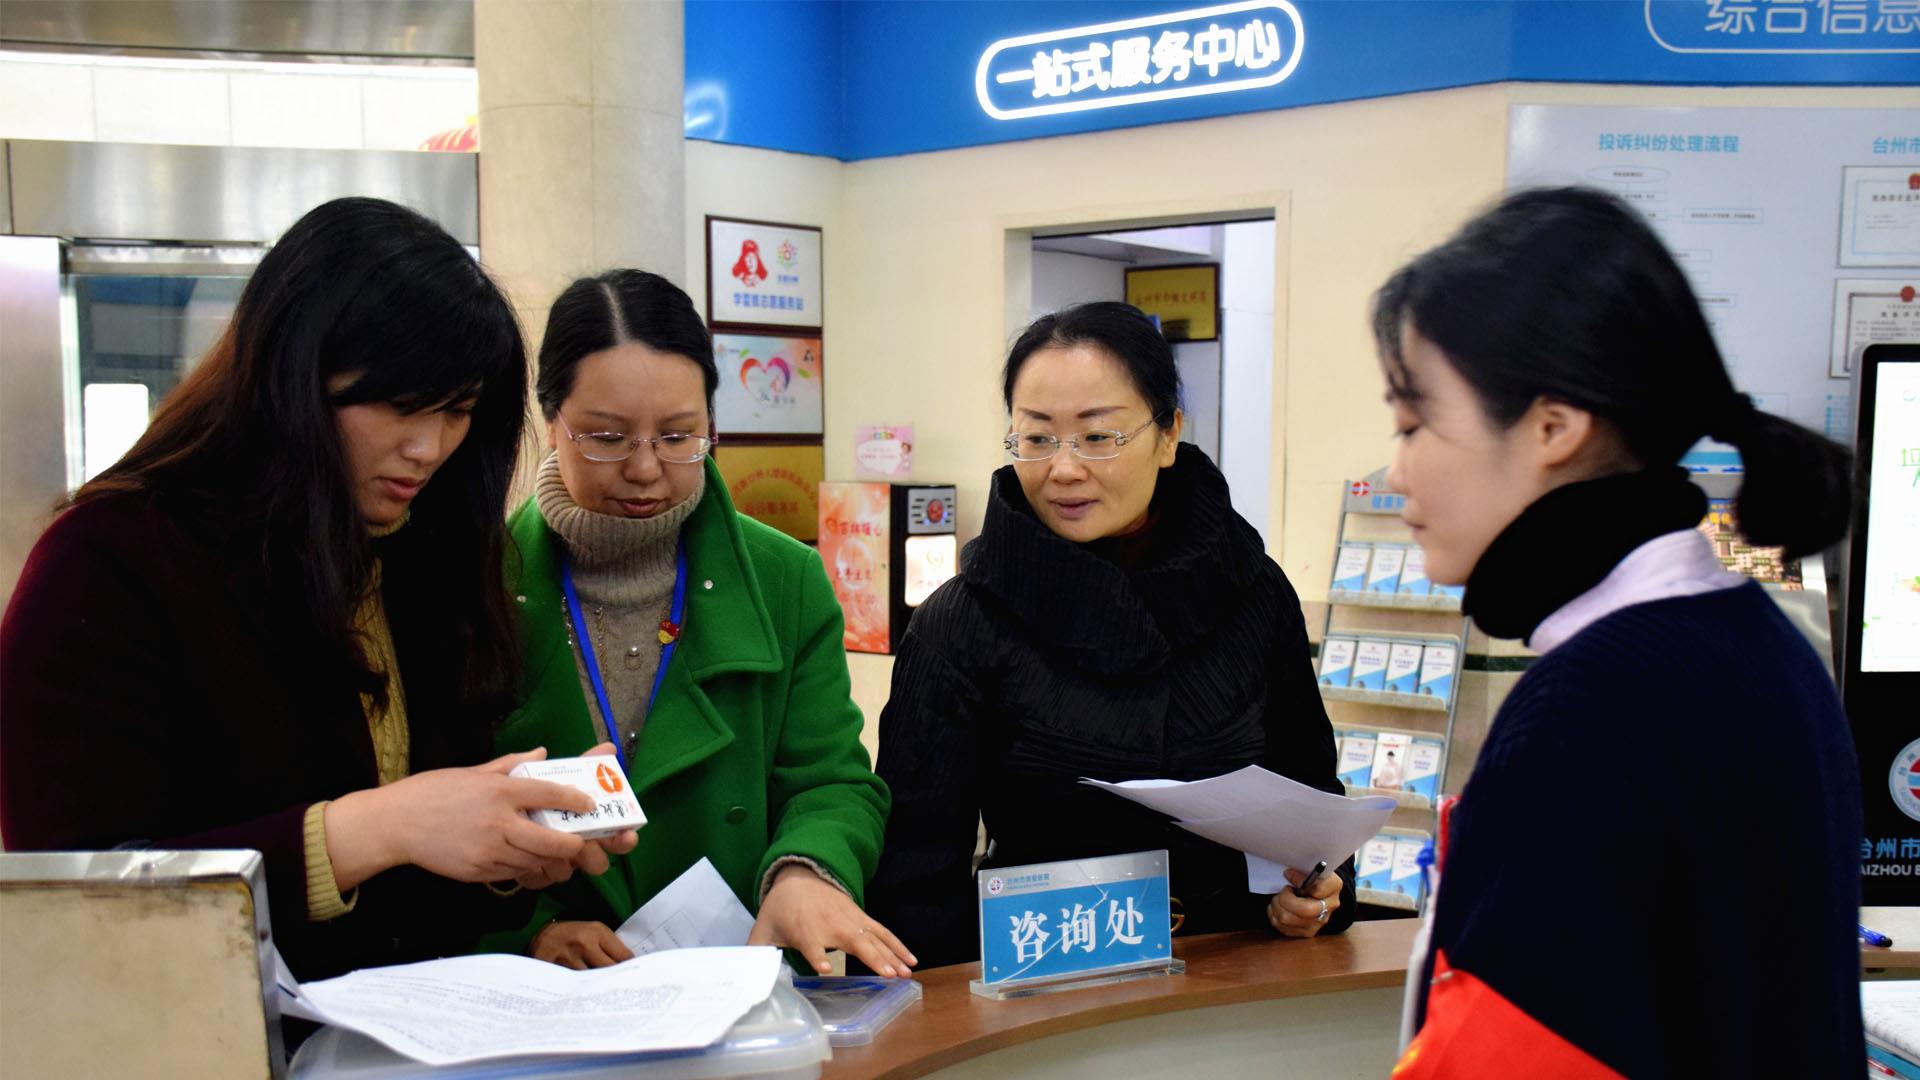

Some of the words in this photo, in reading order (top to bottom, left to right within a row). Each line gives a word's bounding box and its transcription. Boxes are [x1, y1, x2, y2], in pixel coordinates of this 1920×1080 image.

[996, 19, 1280, 98] 一站式服务中心
[1598, 134, 1739, 153] 投诉纠纷处理流程
[1009, 897, 1145, 964] 咨询处
